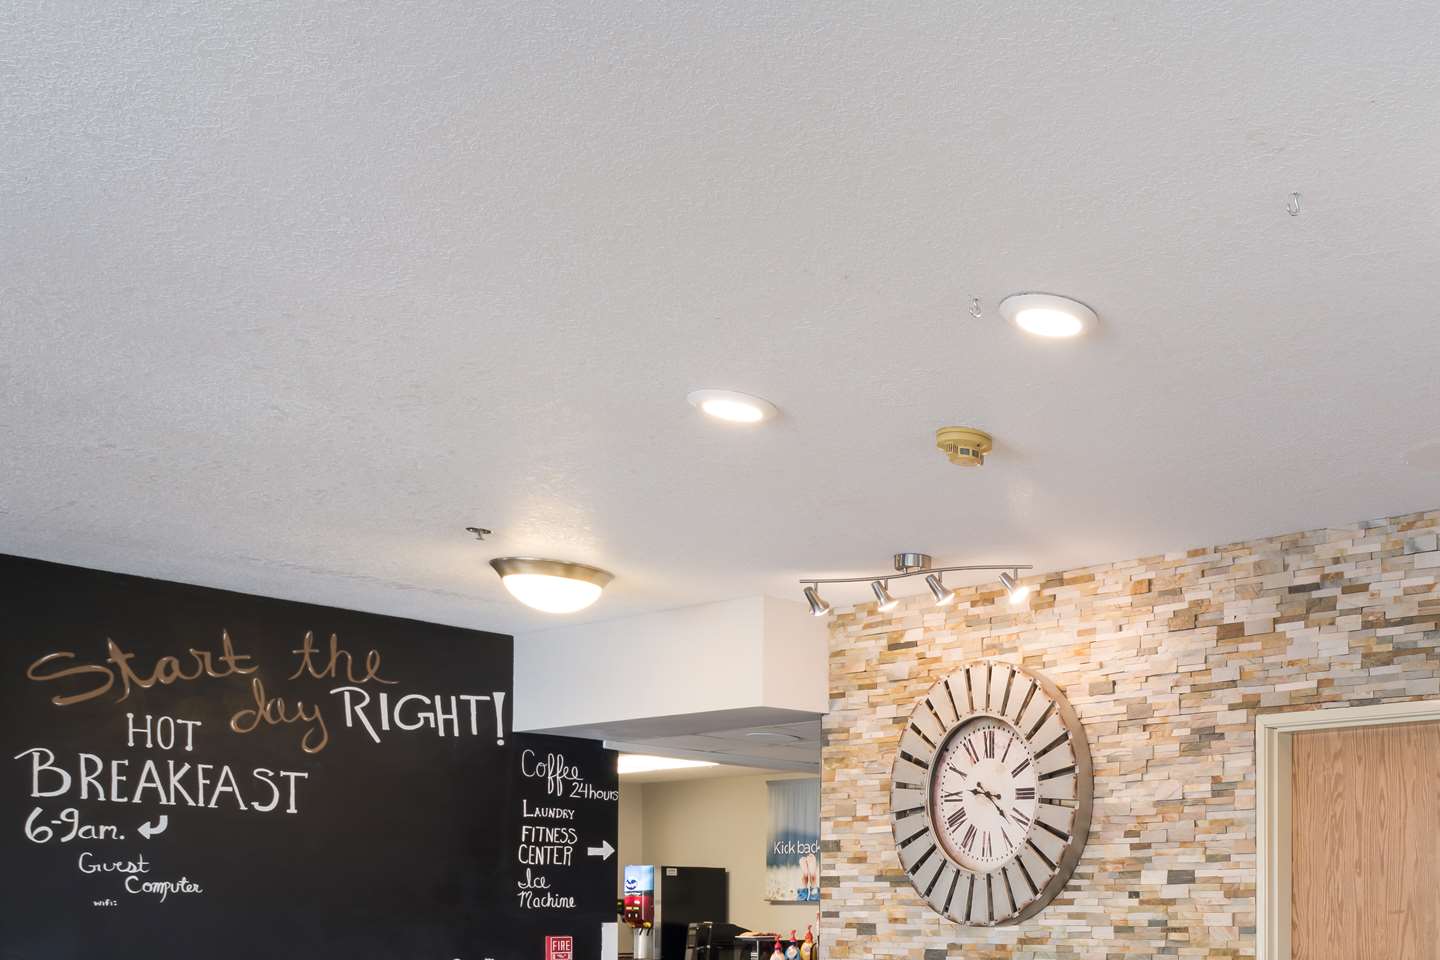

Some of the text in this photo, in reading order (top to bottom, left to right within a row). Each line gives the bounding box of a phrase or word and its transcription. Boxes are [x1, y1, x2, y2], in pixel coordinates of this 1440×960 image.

[26, 628, 401, 706] Start the
[230, 677, 507, 754] day RIGHT!
[126, 712, 203, 752] HOT
[14, 747, 309, 814] BREAKFAST
[521, 749, 584, 797] Coffee
[522, 826, 577, 844] FITNESS
[518, 844, 573, 866] CENTER
[773, 840, 796, 855] Kick
[78, 852, 150, 874] Guest
[124, 875, 204, 903] Computer
[517, 868, 551, 889] Ice
[517, 890, 576, 909] Machine
[552, 940, 571, 951] FIRE
